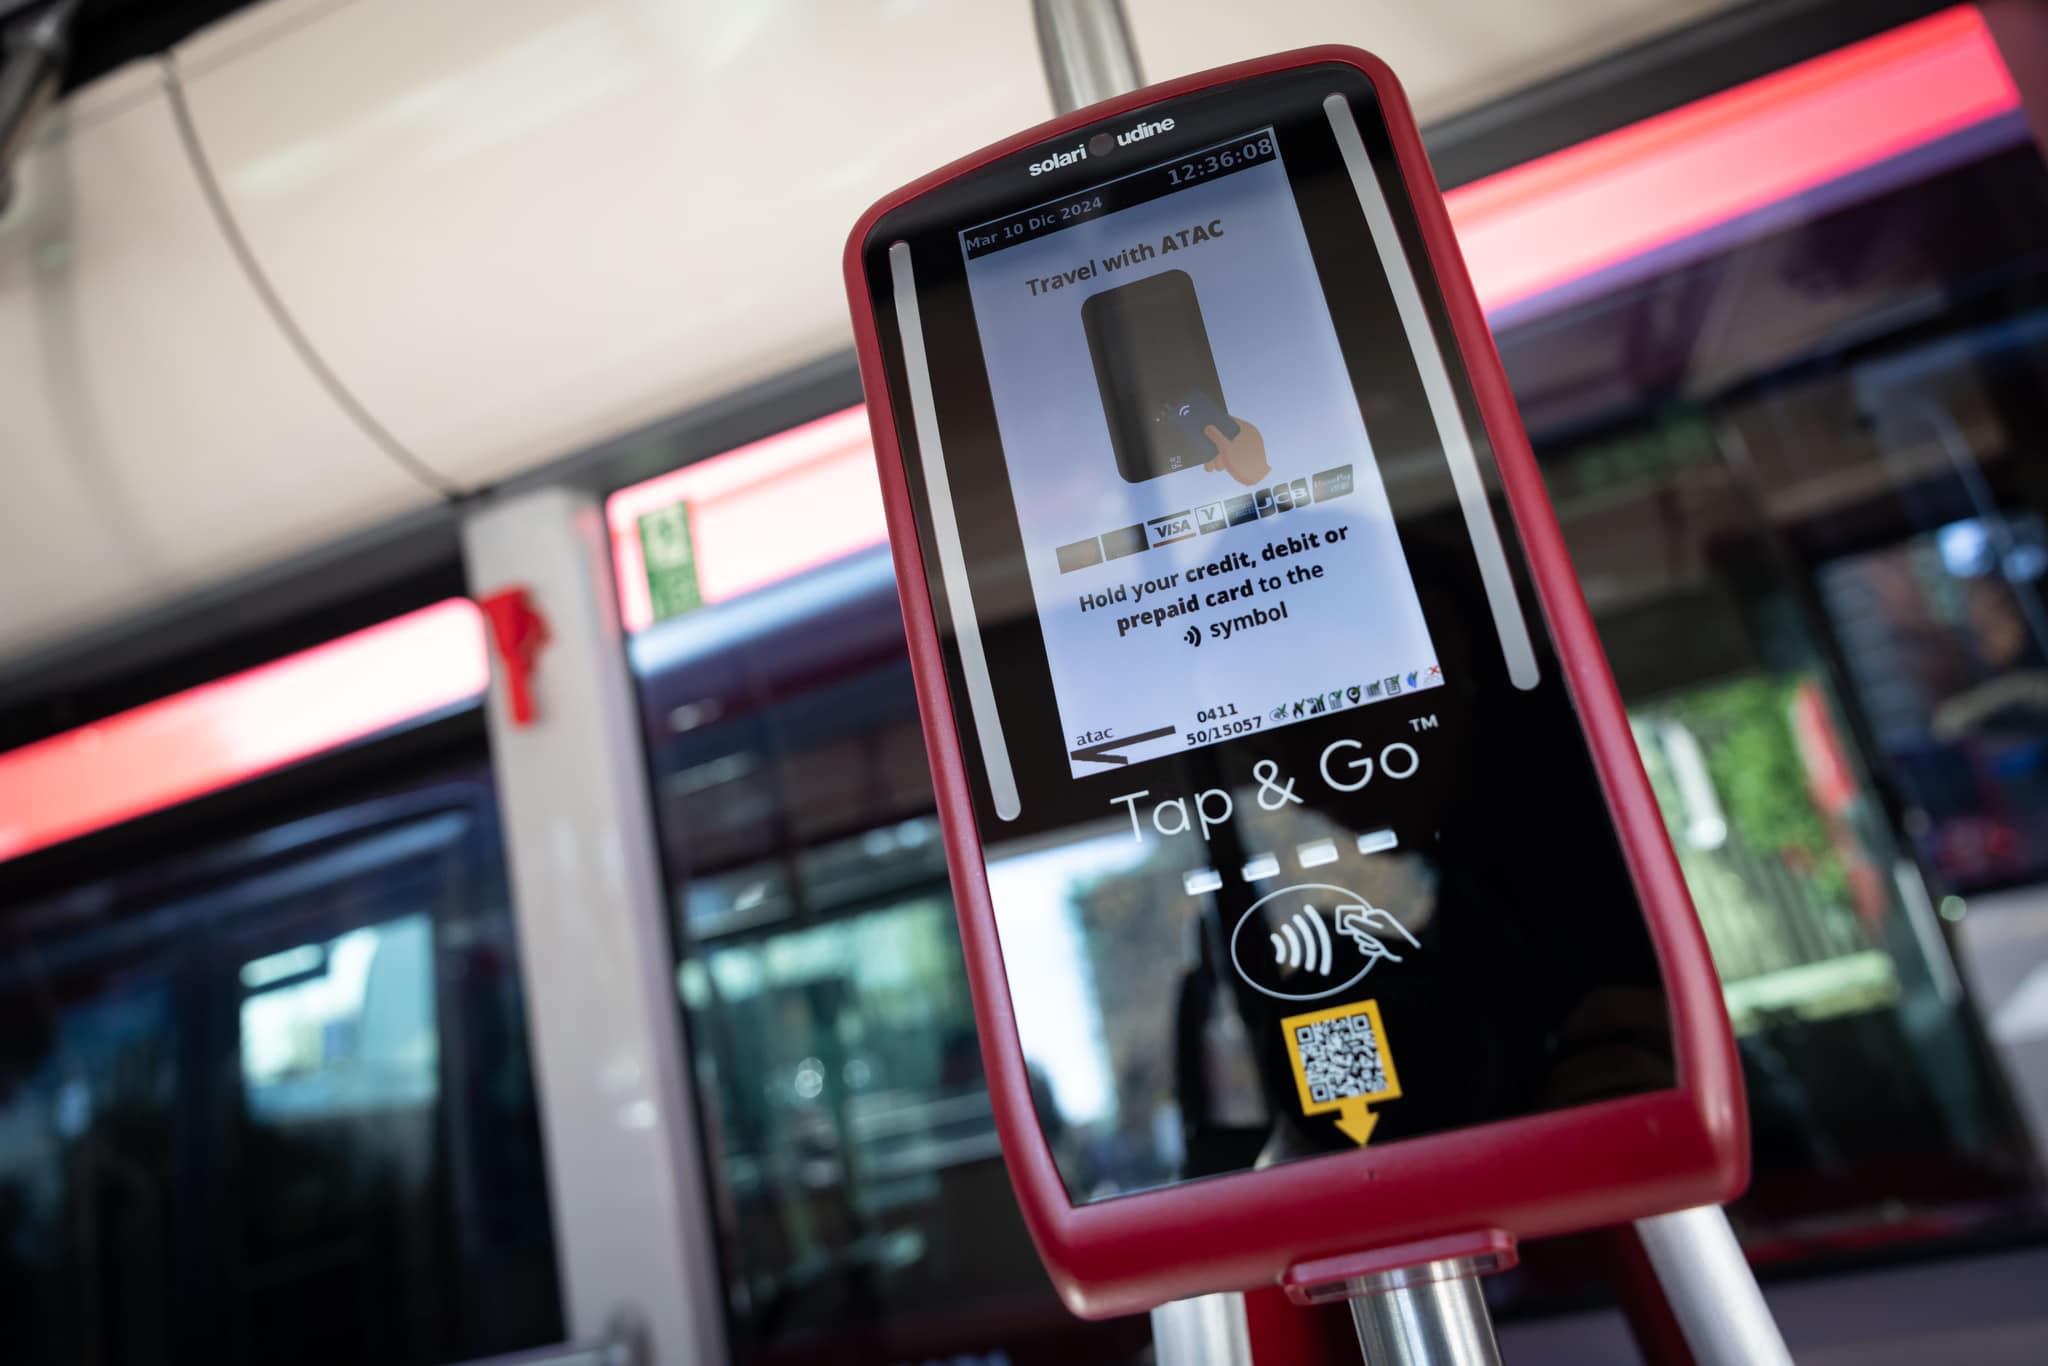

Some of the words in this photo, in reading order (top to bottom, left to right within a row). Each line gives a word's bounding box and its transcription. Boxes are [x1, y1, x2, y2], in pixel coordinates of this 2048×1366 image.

[1029, 144, 1087, 177] solari
[1117, 116, 1176, 148] udine
[1168, 138, 1273, 187] 12:36:08
[966, 231, 998, 252] Mar
[1002, 223, 1024, 240] 10
[1029, 212, 1056, 233] Dic
[1061, 197, 1104, 222] 2024
[1026, 260, 1097, 297] Travel
[1102, 243, 1156, 273] with
[1161, 219, 1225, 256] ATAC
[1257, 487, 1308, 509] JCB
[1154, 519, 1192, 539] VISA
[1079, 584, 1127, 612] Hold
[1132, 574, 1180, 604] your
[1185, 551, 1257, 583] credit,
[1262, 533, 1321, 562] debit
[1325, 525, 1349, 544] or
[1117, 595, 1200, 637] prepaid
[1205, 579, 1254, 608] card
[1258, 575, 1282, 593] to
[1286, 563, 1325, 586] the
[1210, 601, 1288, 639] symbol
[1076, 728, 1114, 746] atac
[1186, 716, 1262, 746] 50/15057
[1197, 703, 1238, 723] 0411
[1110, 789, 1233, 843] Tap
[1252, 759, 1304, 811] &
[1320, 739, 1419, 792] Go
